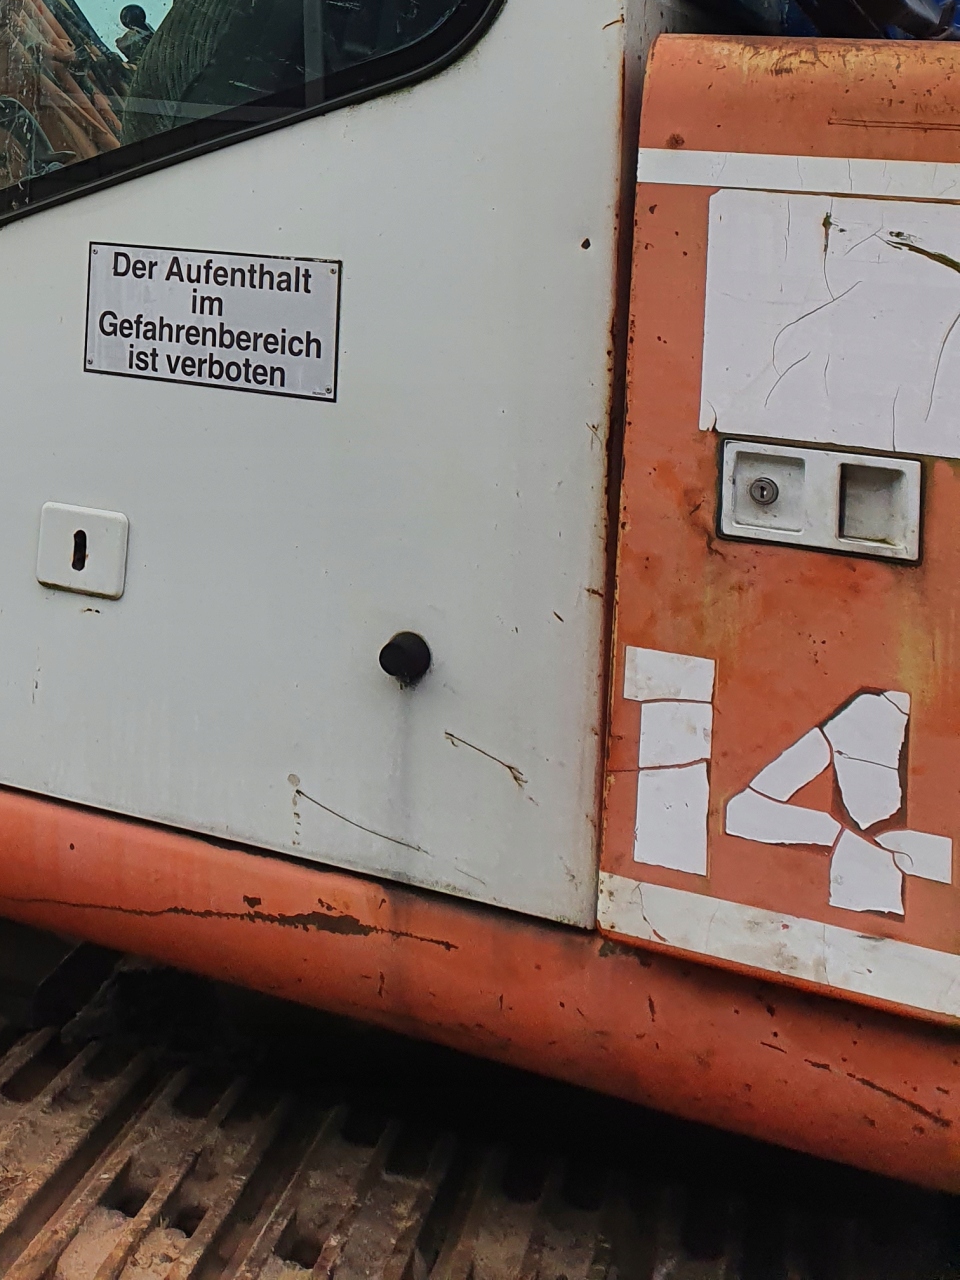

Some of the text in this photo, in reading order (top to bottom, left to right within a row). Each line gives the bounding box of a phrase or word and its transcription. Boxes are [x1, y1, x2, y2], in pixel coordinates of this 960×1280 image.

[112, 251, 312, 294] Der Aufenthalt
[191, 288, 223, 317] im
[98, 310, 322, 359] Gefahrenbereich
[128, 345, 286, 388] ist verboten
[623, 644, 953, 917] 14
